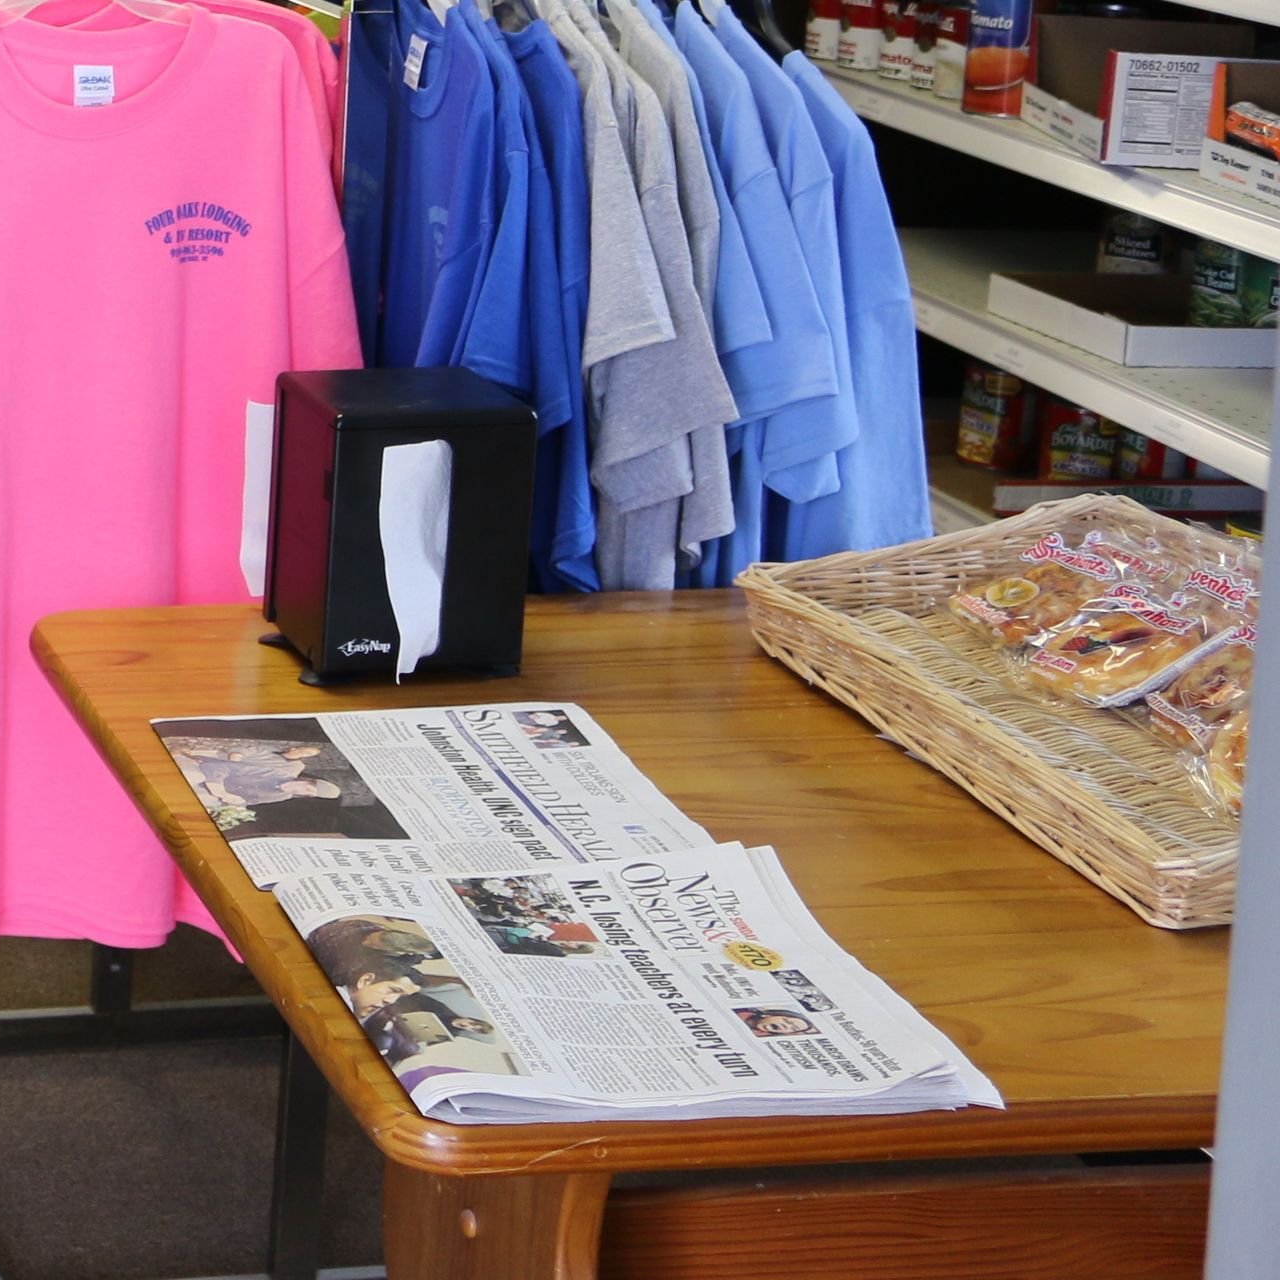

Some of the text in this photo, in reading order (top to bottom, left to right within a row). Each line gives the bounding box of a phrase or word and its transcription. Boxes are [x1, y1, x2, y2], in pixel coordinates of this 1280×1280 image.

[970, 11, 1014, 30] Tomato
[1129, 59, 1200, 73] 70662-01502
[144, 202, 252, 238] FOUR OAKS LODGING
[163, 229, 232, 244] & RESORT
[1114, 236, 1152, 250] Sliced
[1108, 244, 1157, 259] Potatoes
[1207, 278, 1236, 290] Beans
[1219, 270, 1236, 280] Cut
[1051, 431, 1116, 451] BOYARDEE
[1067, 453, 1097, 465] Mini
[347, 639, 391, 655] EasyNap
[416, 723, 564, 864] Johnston Health, UNC sign pact
[463, 708, 621, 863] SMITHFIELD HERAL
[323, 849, 352, 867] plan
[349, 849, 378, 868] jobs
[375, 844, 413, 874] to draft
[401, 845, 433, 873] County
[322, 873, 351, 892] poker
[349, 873, 367, 886] has
[620, 862, 709, 953] Observer
[665, 871, 726, 929] News
[714, 890, 740, 916] The
[568, 879, 759, 1078] N.C. losing teachers at every turn
[776, 1040, 820, 1071] CRITICISM
[795, 1038, 843, 1077] THOUSANDS,
[814, 1038, 870, 1083] MARCH DRAWS
